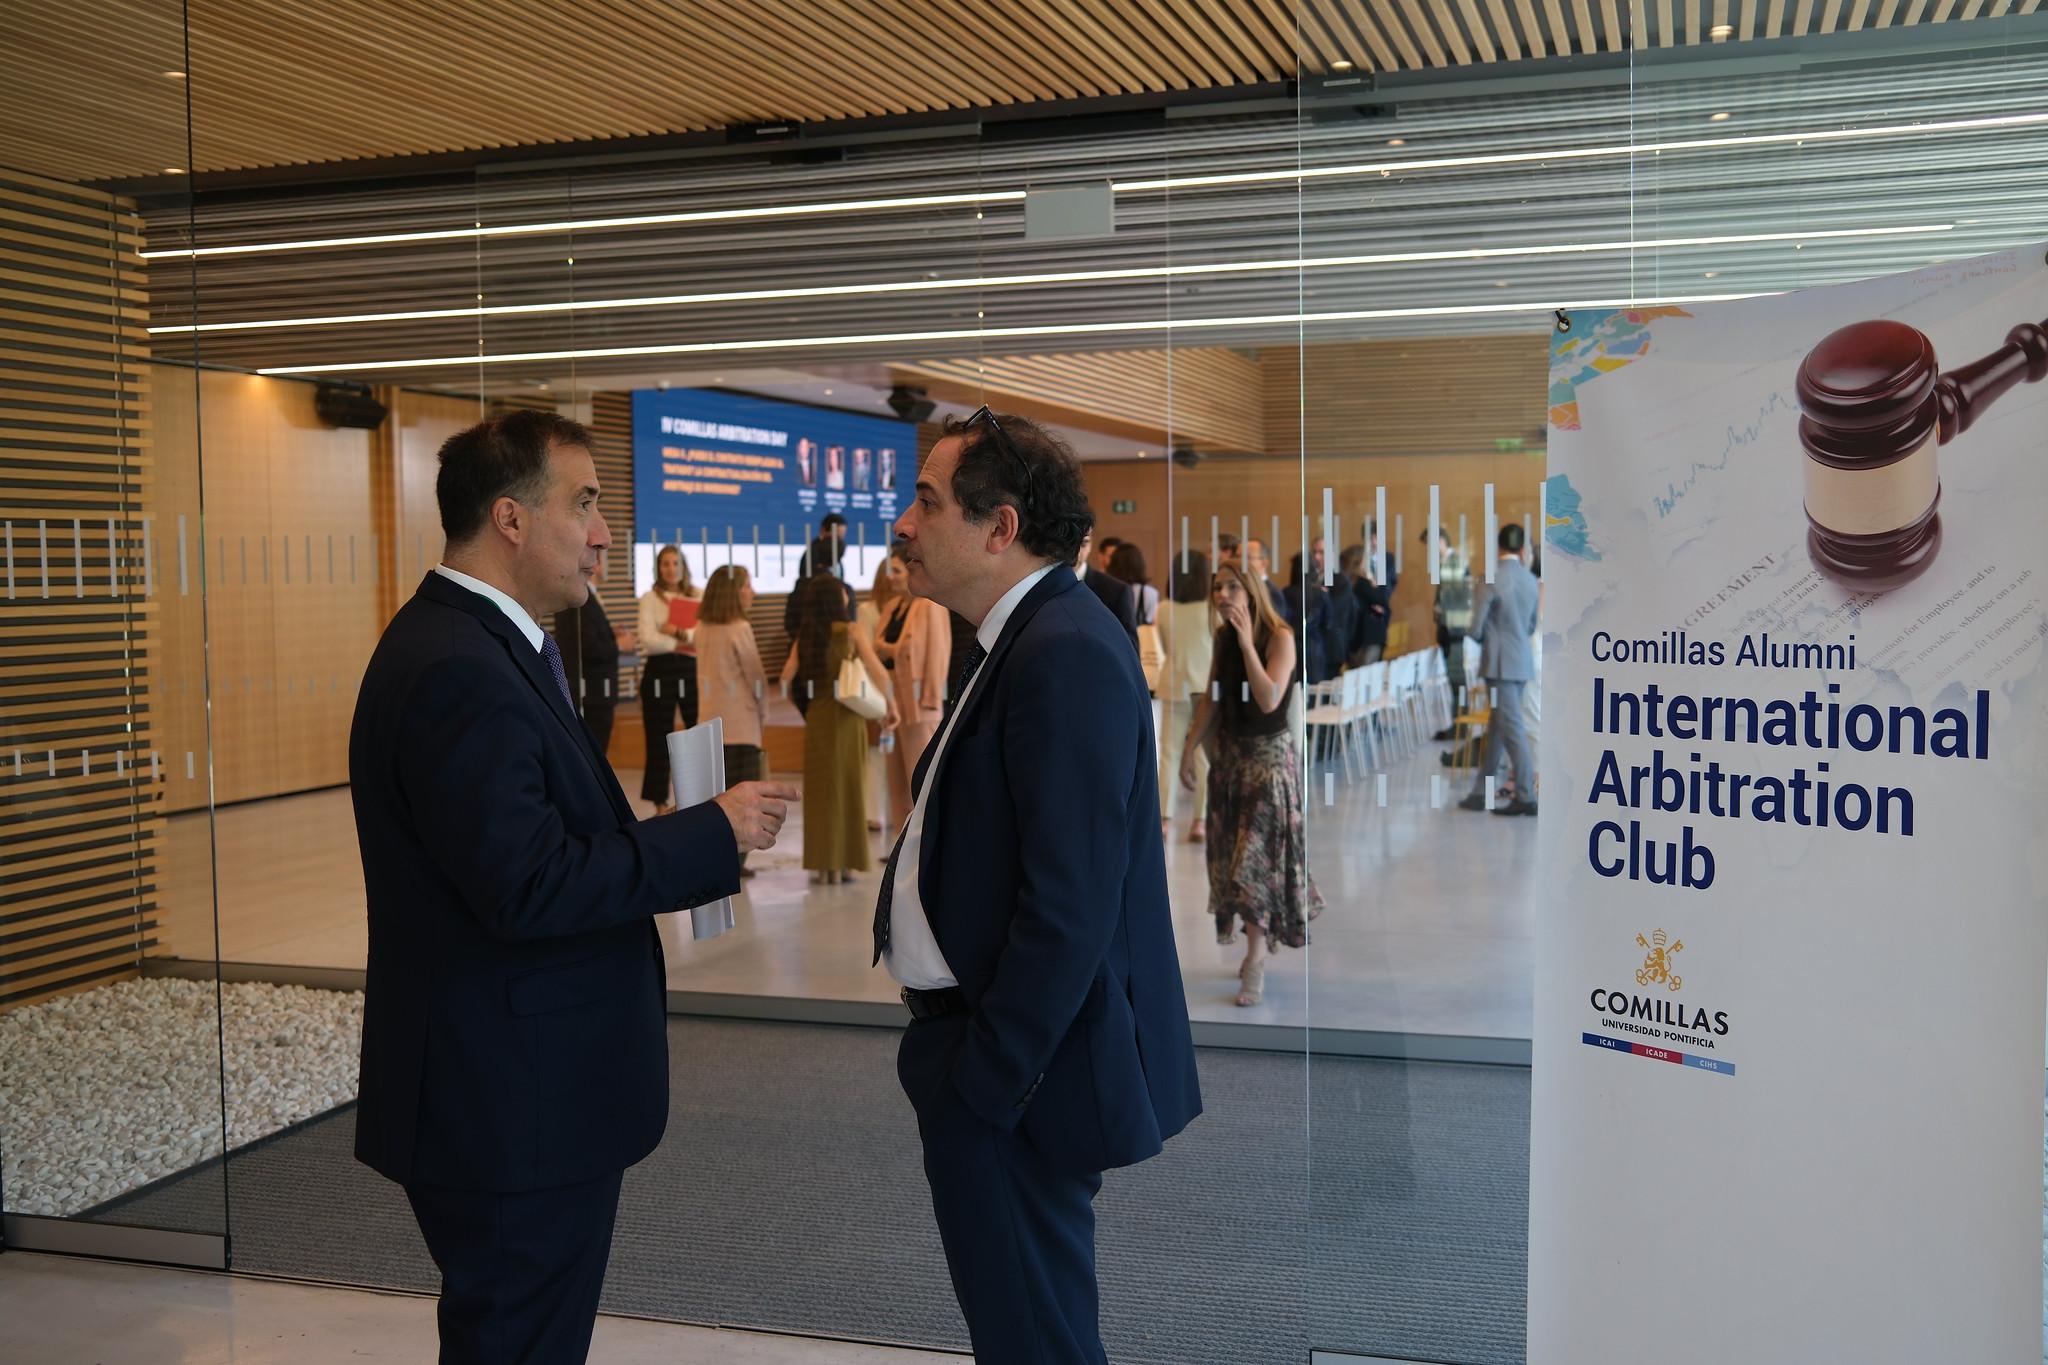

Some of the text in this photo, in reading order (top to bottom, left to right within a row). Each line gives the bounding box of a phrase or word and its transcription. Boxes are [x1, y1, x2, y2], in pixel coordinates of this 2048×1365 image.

[673, 418, 717, 439] COMILLAS
[718, 424, 770, 445] ARBITRATION
[1676, 552, 1777, 633] AGREEMENT
[1782, 569, 1818, 598] January
[1796, 582, 1818, 600] John
[1903, 622, 1919, 638] for
[1966, 571, 1986, 589] and
[1984, 563, 1997, 575] to
[1958, 599, 1996, 629] whether
[1995, 587, 2011, 601] on
[2018, 568, 2033, 586] job
[1591, 631, 1725, 666] Comillas
[1736, 633, 1855, 671] Alumni
[1593, 678, 1990, 761] International
[1588, 750, 1914, 837] Arbitration
[1588, 820, 1716, 890] Club
[1590, 988, 1729, 1036] COMILLAS
[1601, 1018, 1715, 1049] UNIVERSIDAD PONTIFICIA
[1599, 1038, 1718, 1070] ICAI ICADE CIHS
